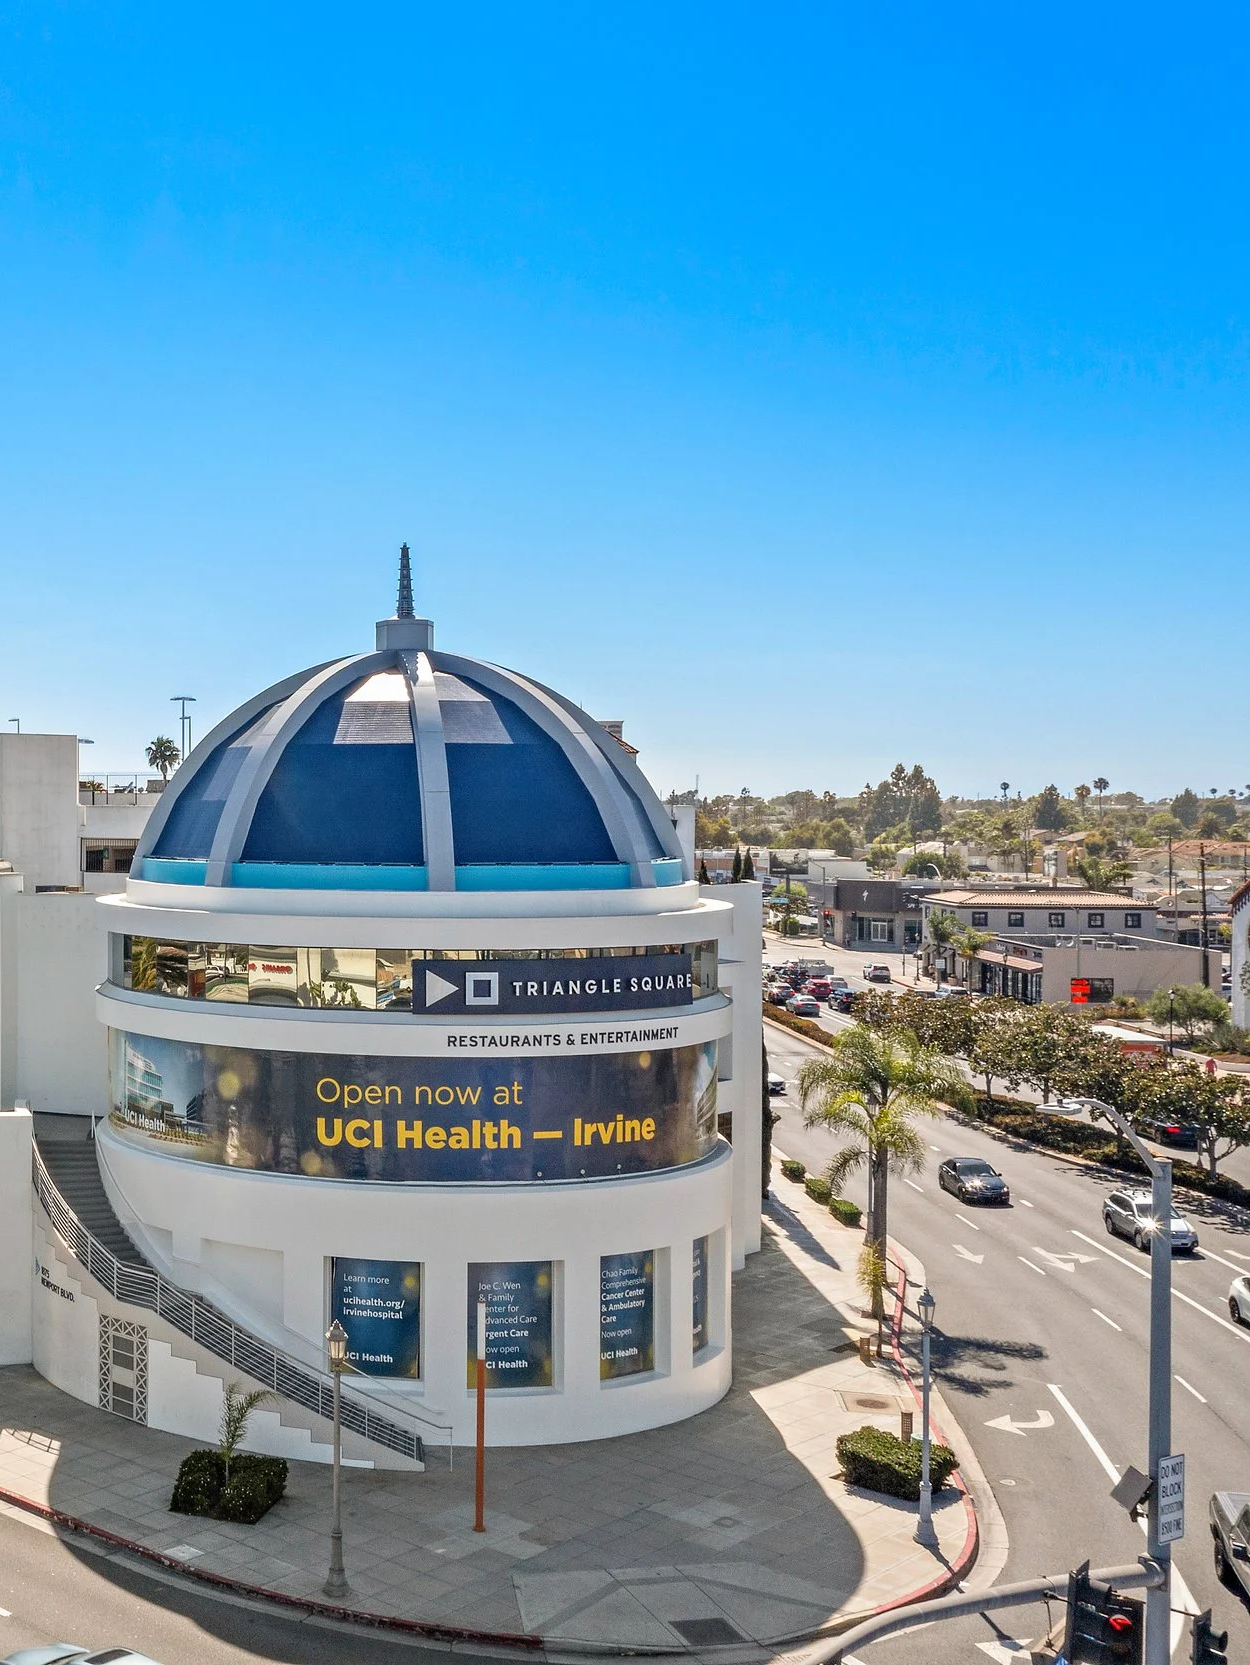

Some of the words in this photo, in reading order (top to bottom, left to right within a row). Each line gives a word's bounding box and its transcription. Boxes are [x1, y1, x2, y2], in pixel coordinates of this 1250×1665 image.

[512, 979, 622, 997] TRIANGLE
[630, 973, 693, 992] SQUARE
[447, 1034, 561, 1048] RESTAURANTS
[566, 1033, 576, 1046] &
[580, 1026, 679, 1046] ENTERTAINMENT
[316, 1077, 402, 1108] Open
[415, 1086, 482, 1105] now
[493, 1081, 523, 1105] at
[125, 1108, 137, 1125] UCI
[138, 1113, 166, 1132] Health
[316, 1117, 383, 1149] UCI
[397, 1119, 522, 1150] Health
[573, 1113, 656, 1147] Irvine
[602, 1270, 619, 1278] Chao
[618, 1266, 639, 1277] Family
[343, 1273, 366, 1283] Learn
[367, 1276, 390, 1284] more
[601, 1276, 646, 1290] Comprehensive
[343, 1285, 352, 1293] at
[478, 1282, 492, 1291] Joe
[493, 1282, 501, 1290] C.
[502, 1281, 521, 1290] Wen
[479, 1293, 486, 1302] &
[487, 1293, 515, 1303] Family
[601, 1292, 624, 1301] Cancer
[624, 1288, 645, 1298] Center
[343, 1297, 406, 1309] ucihealth.org/
[485, 1305, 506, 1313] enter
[507, 1304, 519, 1312] for
[601, 1304, 608, 1312] &
[608, 1299, 645, 1311] Ambulatory
[343, 1307, 403, 1320] irvinehospital
[601, 1315, 617, 1323] Care
[485, 1316, 518, 1325] dvanced
[519, 1315, 538, 1323] Care
[485, 1330, 508, 1340] rgent
[509, 1329, 529, 1337] Care
[601, 1331, 616, 1339] Now
[616, 1328, 632, 1337] open
[499, 1345, 520, 1354] open
[600, 1352, 614, 1360] UCI
[615, 1347, 638, 1358] Health
[362, 1353, 393, 1363] Health
[498, 1360, 528, 1369] Health
[1161, 1465, 1170, 1479] DO
[1171, 1461, 1183, 1477] NOT
[1162, 1482, 1183, 1498] BLOCK
